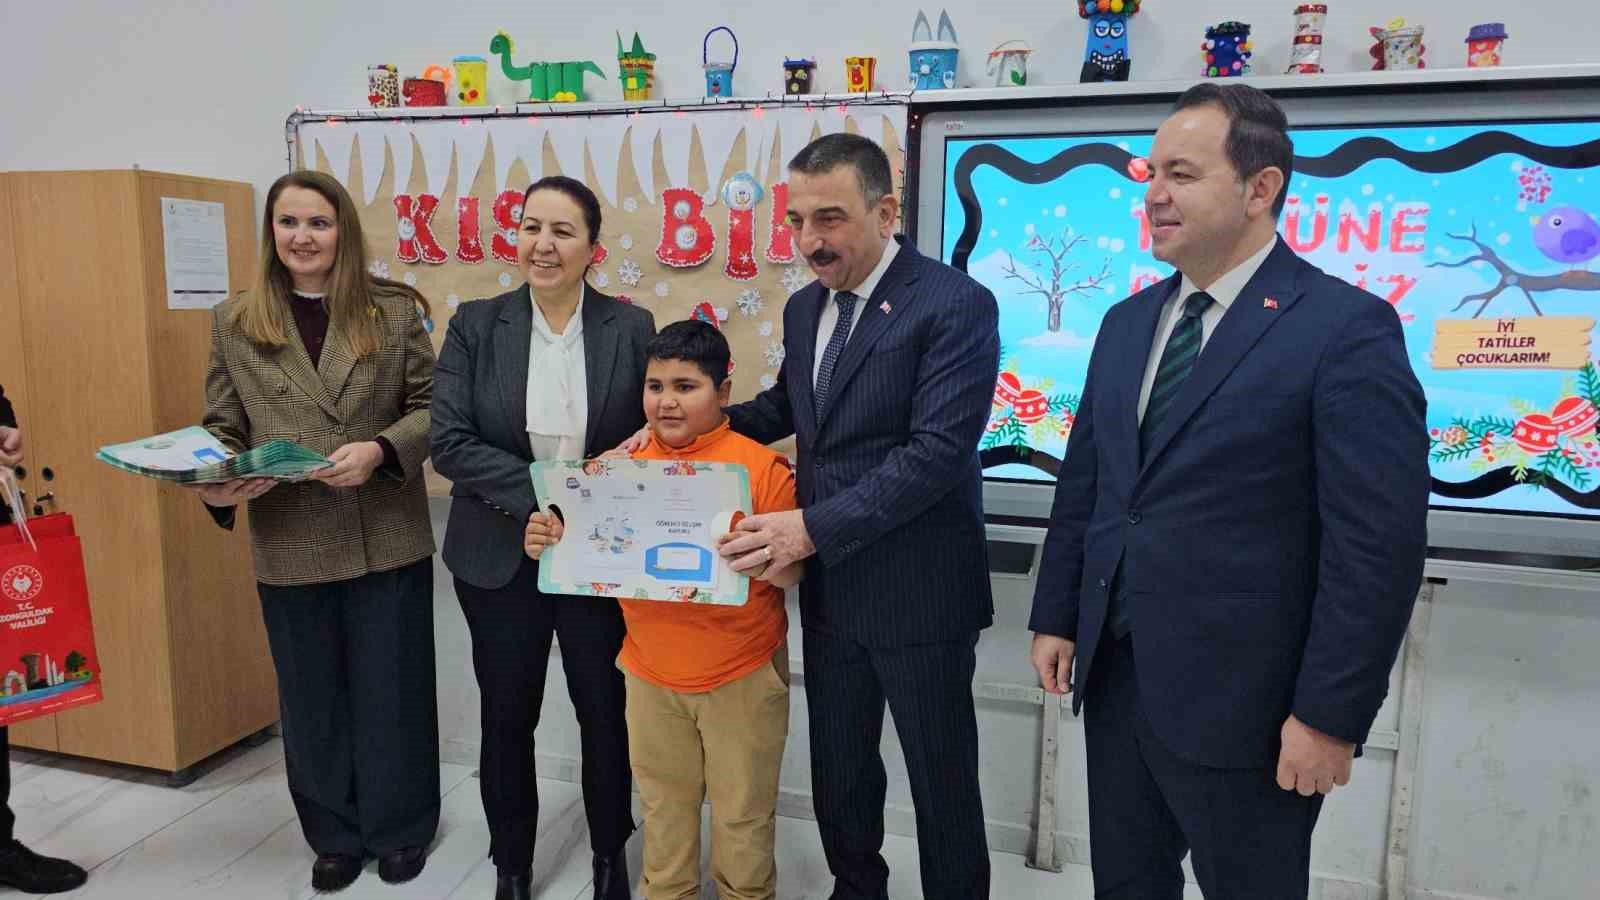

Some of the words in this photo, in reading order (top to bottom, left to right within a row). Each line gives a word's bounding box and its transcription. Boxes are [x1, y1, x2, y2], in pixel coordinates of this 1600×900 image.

[1497, 318, 1516, 333] İYİ
[1477, 334, 1536, 348] TATİLLER
[1456, 352, 1551, 366] ÇOCUKLARIM!
